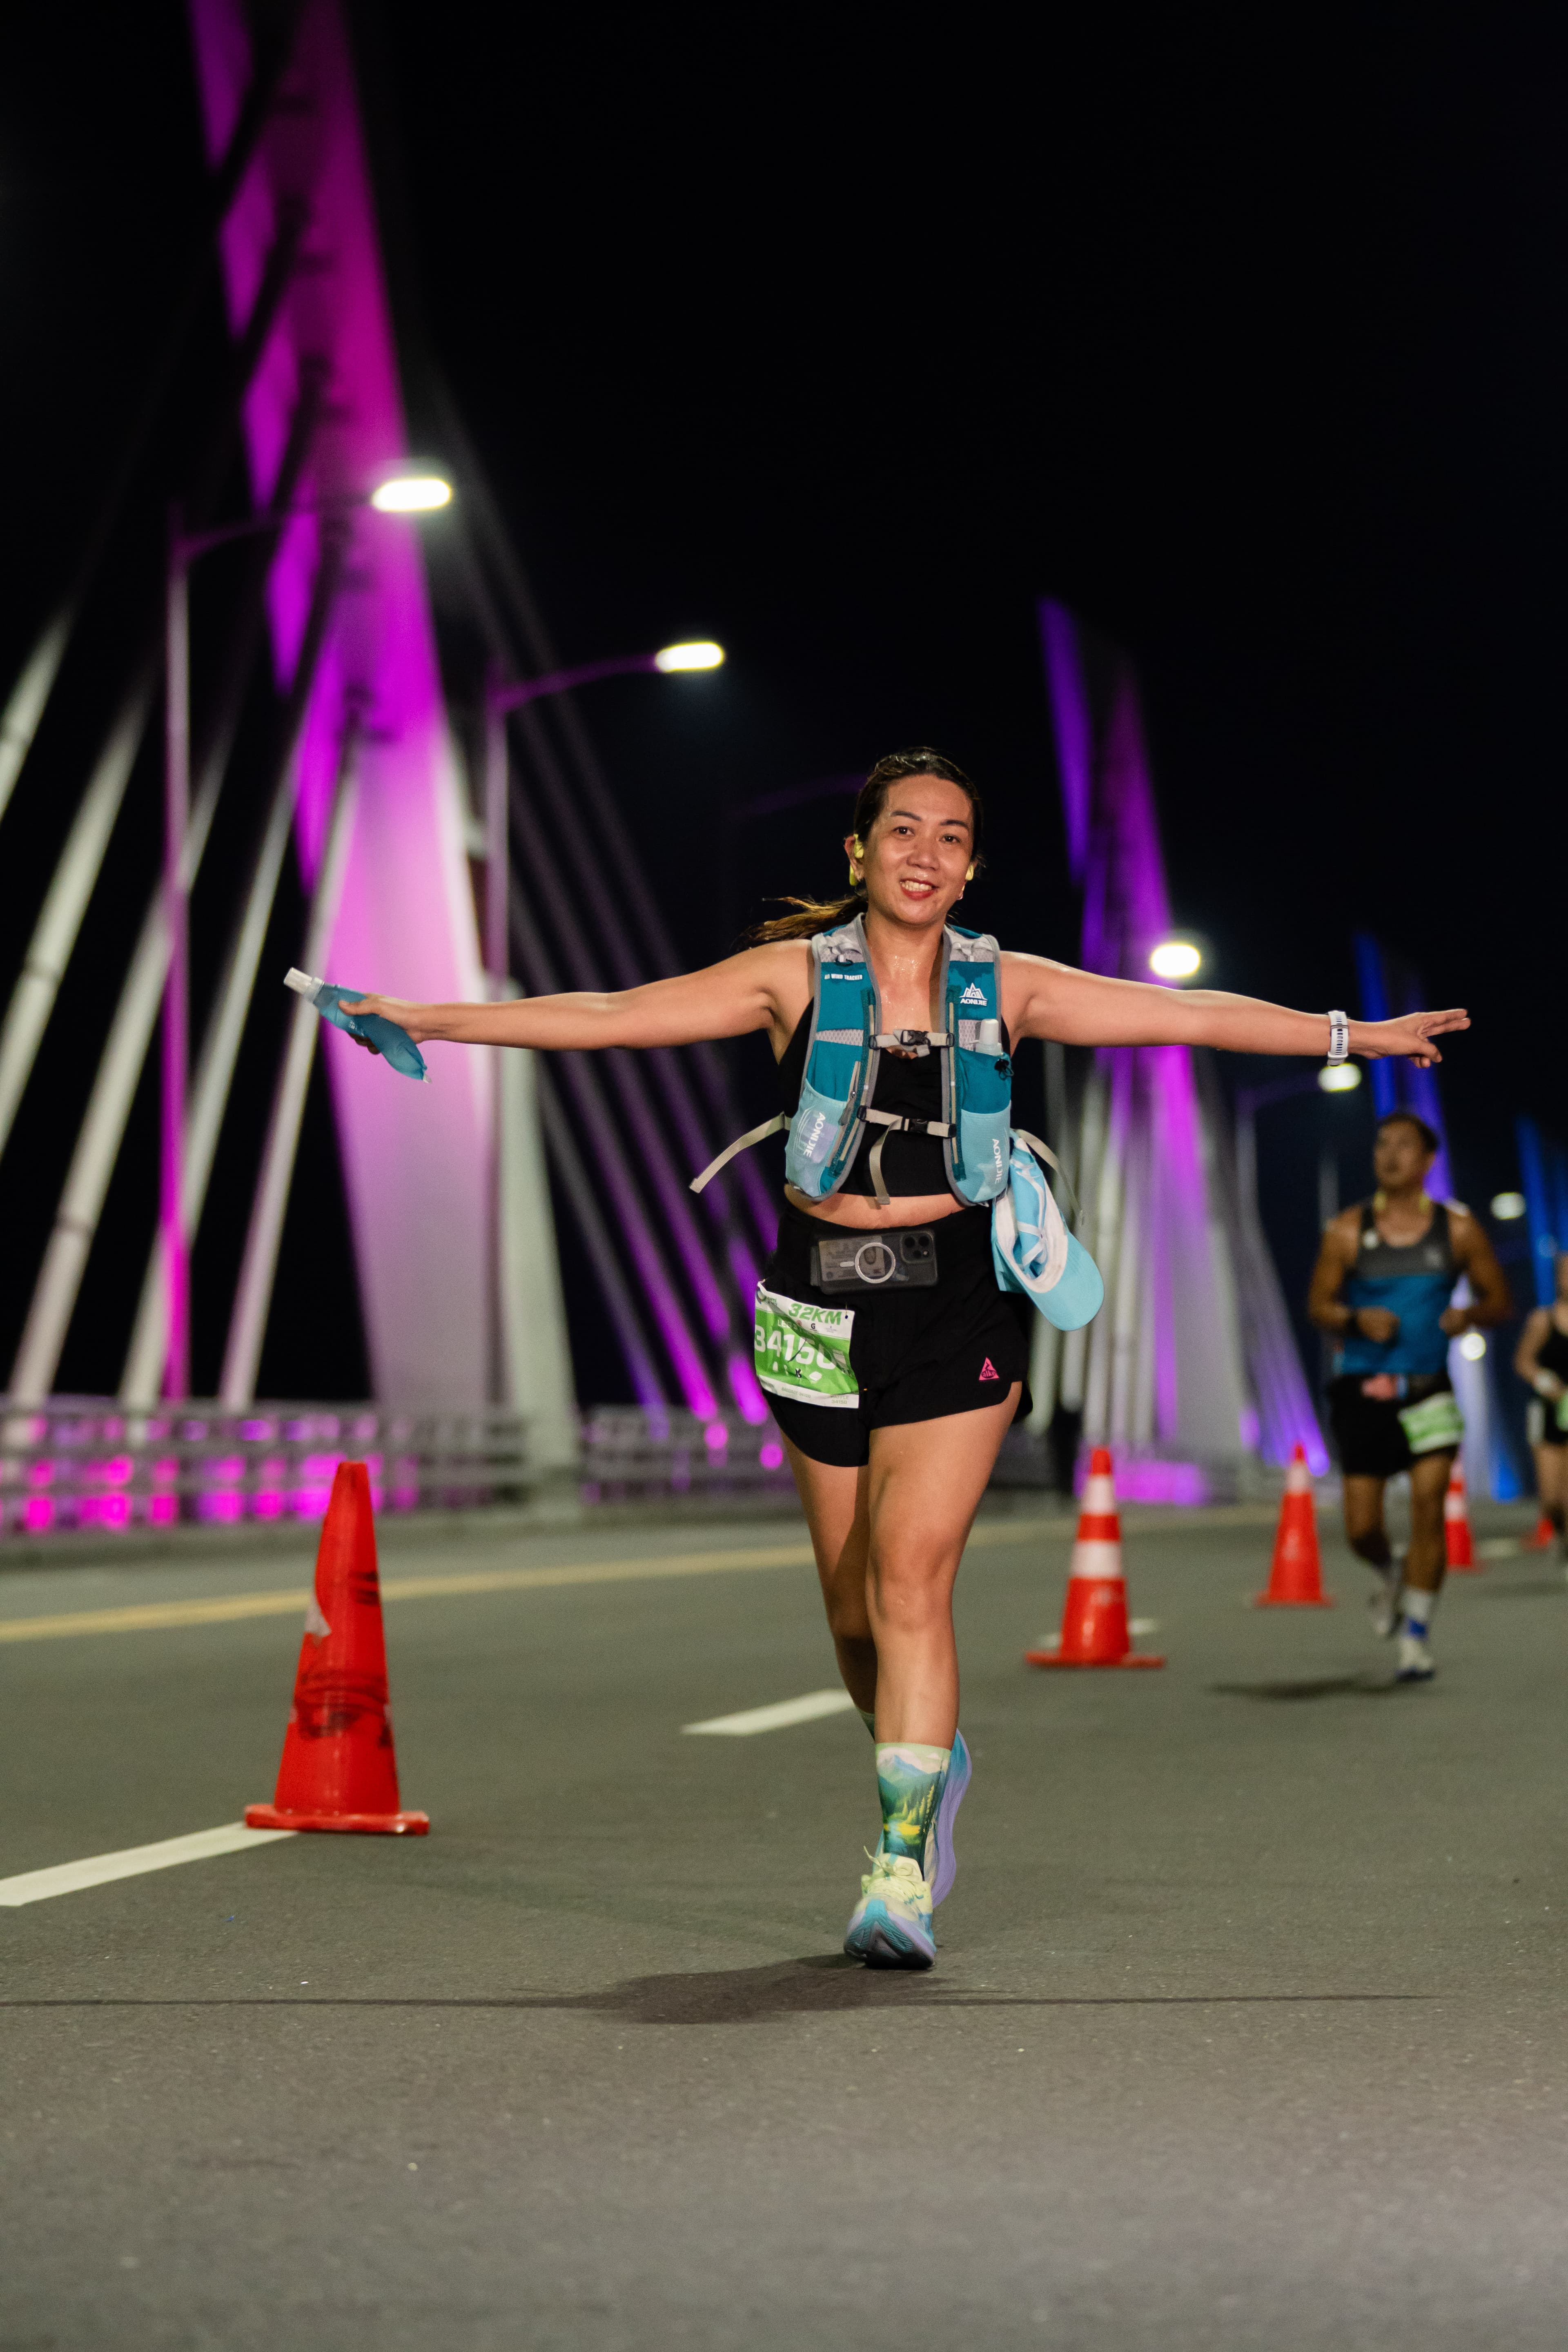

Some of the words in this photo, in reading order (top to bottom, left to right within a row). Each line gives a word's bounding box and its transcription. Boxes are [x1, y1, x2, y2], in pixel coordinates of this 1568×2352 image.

[803, 1112, 826, 1157] AONIJIE
[992, 1138, 1003, 1185] AONIJIE
[788, 1303, 842, 1325] 32KM
[754, 1324, 837, 1370] 34150
